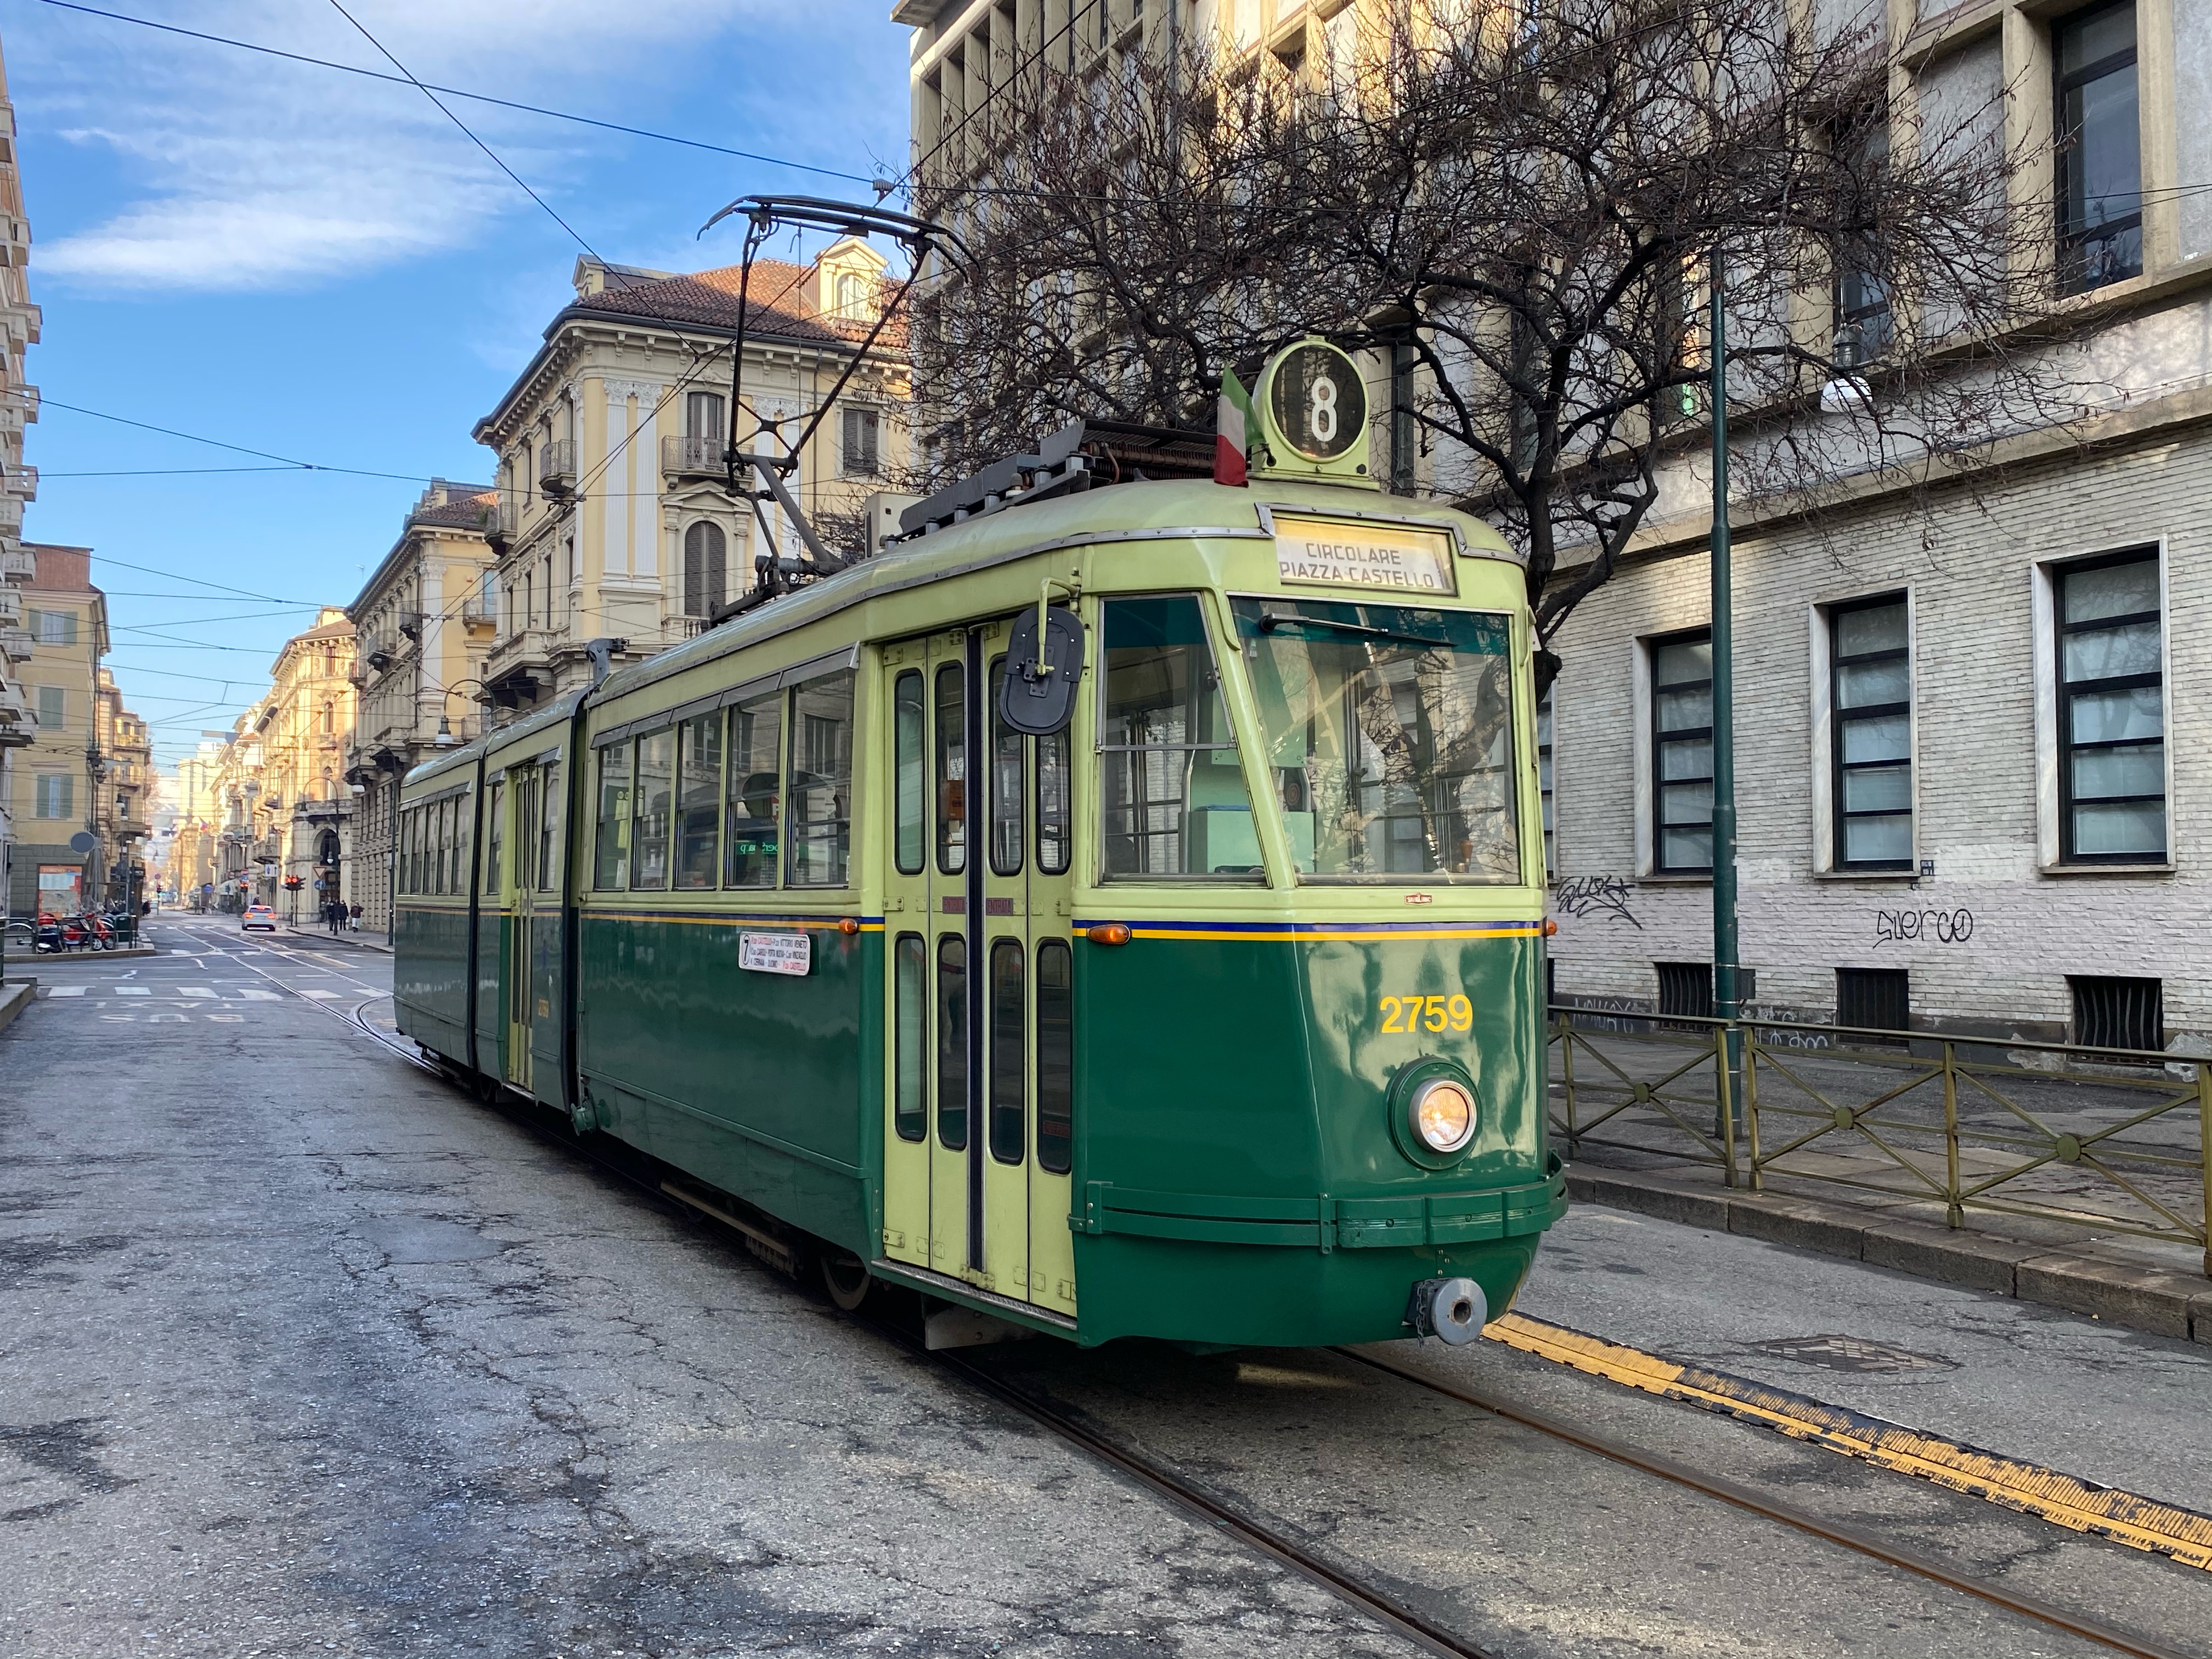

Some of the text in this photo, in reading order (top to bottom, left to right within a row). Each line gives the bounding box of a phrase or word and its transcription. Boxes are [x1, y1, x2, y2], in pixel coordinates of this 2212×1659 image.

[1311, 376, 1338, 442] 8
[1306, 543, 1402, 565] CIRCOLARE
[1279, 561, 1435, 588] PIAZZA CASTELLO
[987, 899, 1012, 913] ENTRATA
[744, 939, 749, 962] 7
[1379, 994, 1474, 1034] 2759
